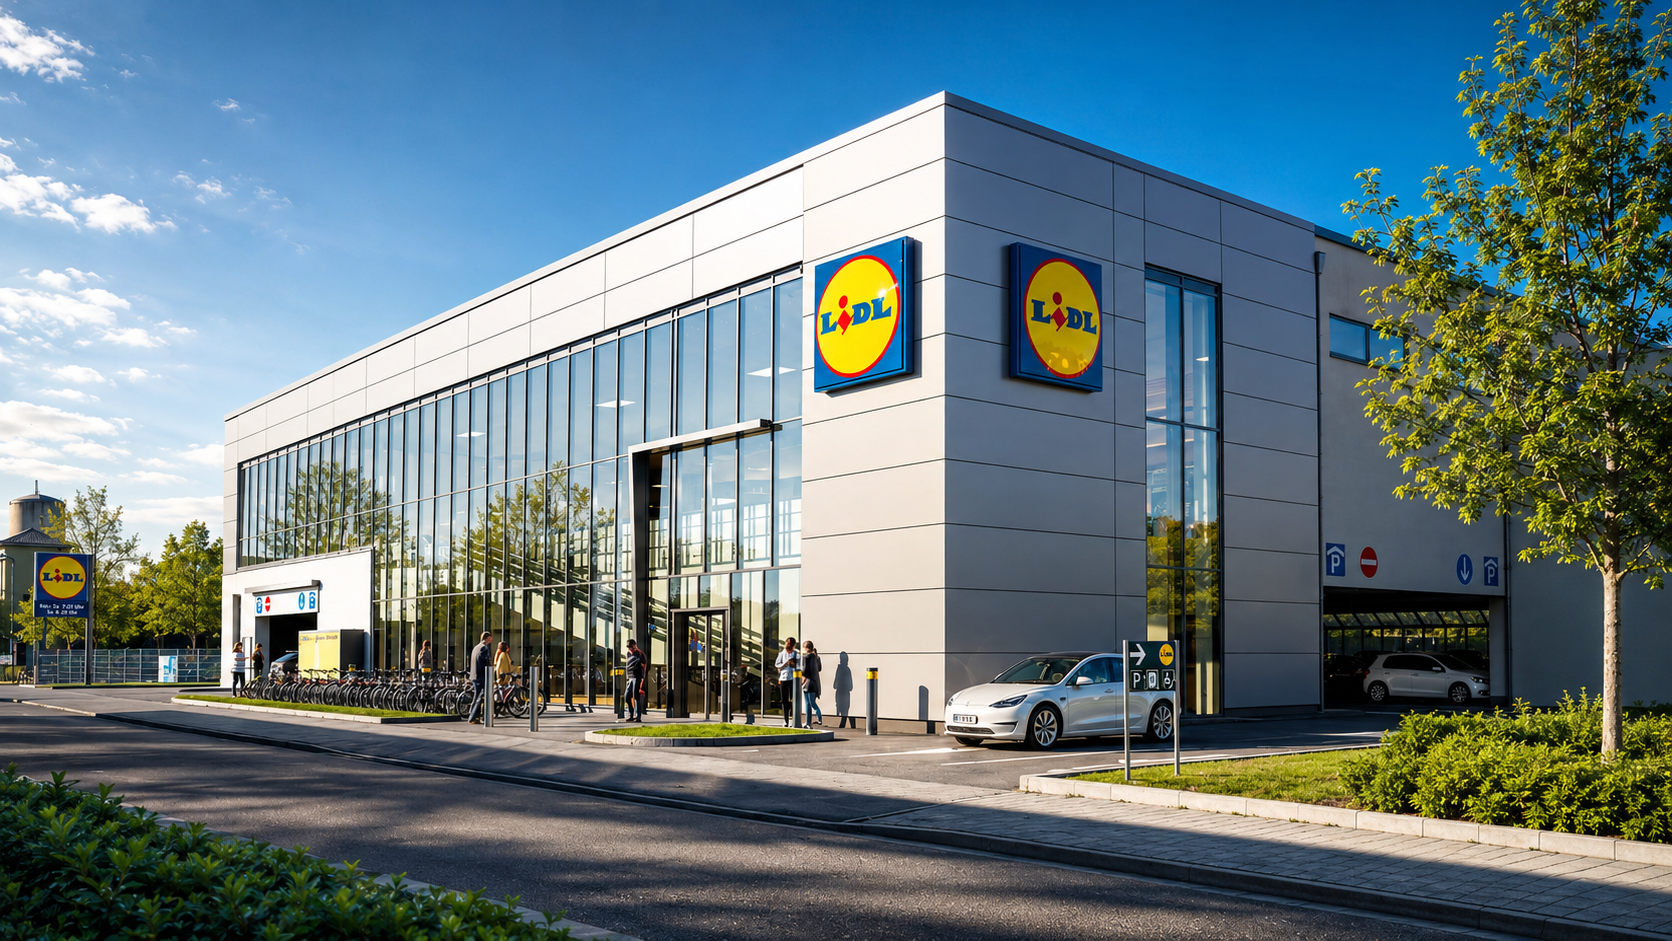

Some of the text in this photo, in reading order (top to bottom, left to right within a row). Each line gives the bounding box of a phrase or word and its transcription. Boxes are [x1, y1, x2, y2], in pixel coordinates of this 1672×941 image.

[1331, 554, 1341, 574] P
[1487, 566, 1495, 584] P
[1133, 672, 1141, 689] P
